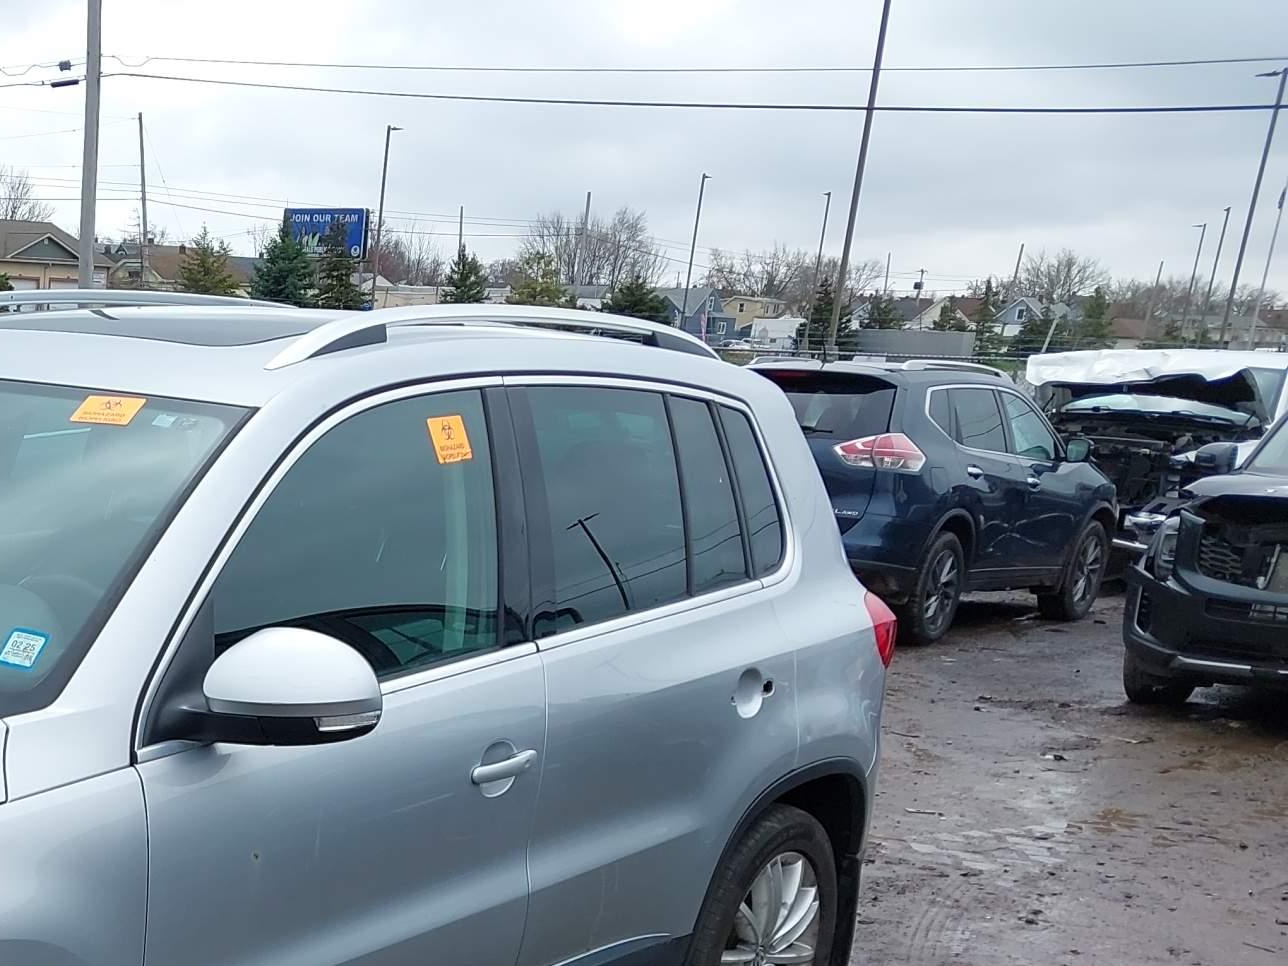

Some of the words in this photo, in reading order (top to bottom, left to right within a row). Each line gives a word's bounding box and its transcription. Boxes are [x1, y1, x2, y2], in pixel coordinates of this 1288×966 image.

[290, 214, 310, 222] JOIN
[313, 214, 331, 222] OUR
[334, 214, 358, 222] TEAM
[11, 639, 23, 649] 02
[23, 642, 36, 652] 25
